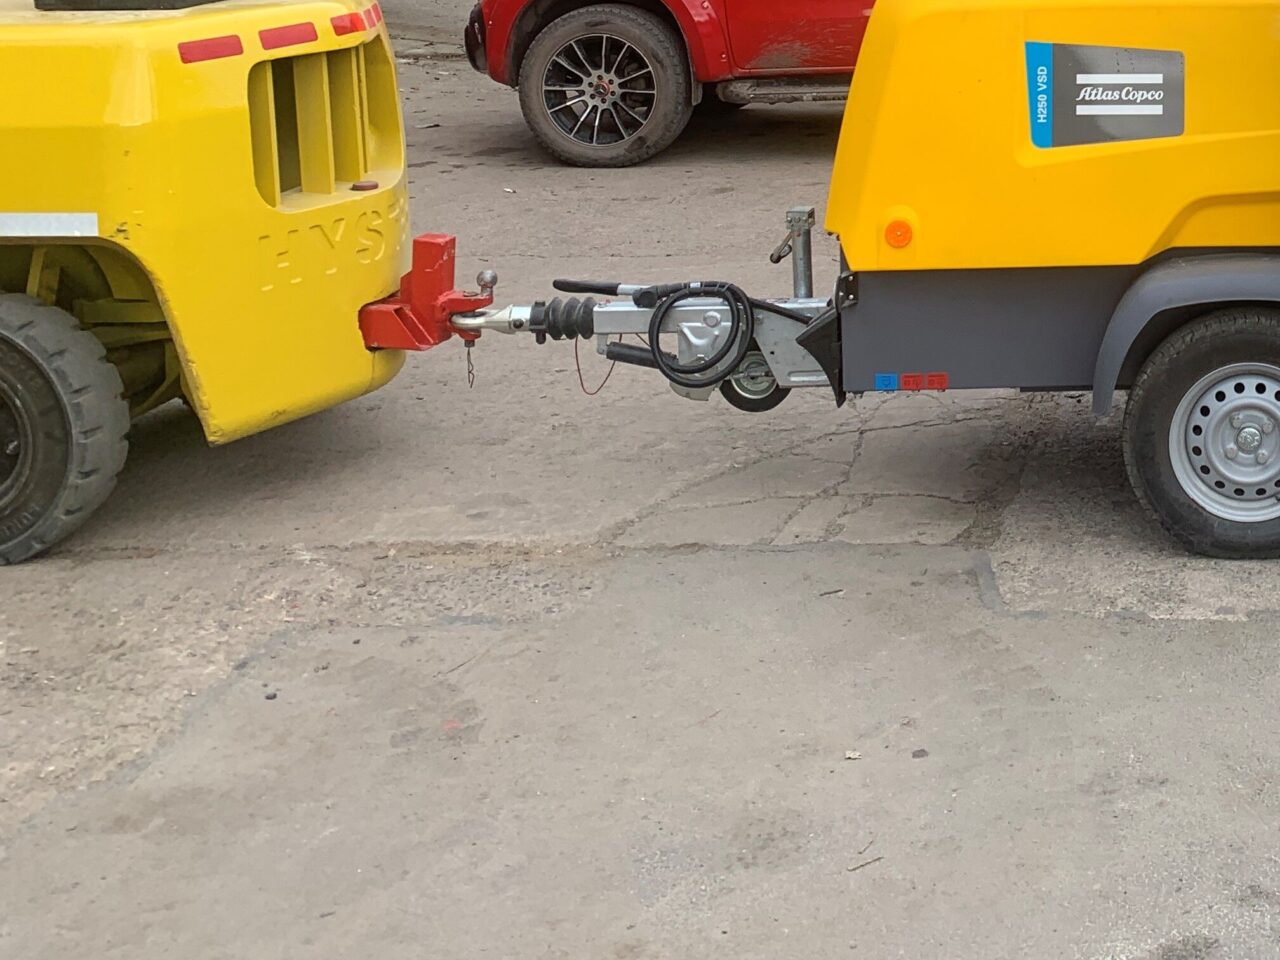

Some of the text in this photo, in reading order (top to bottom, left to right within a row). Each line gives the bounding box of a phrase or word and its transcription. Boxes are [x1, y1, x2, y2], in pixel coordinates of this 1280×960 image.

[1037, 66, 1047, 123] H250 VSD
[1076, 86, 1164, 103] Atlas Copco
